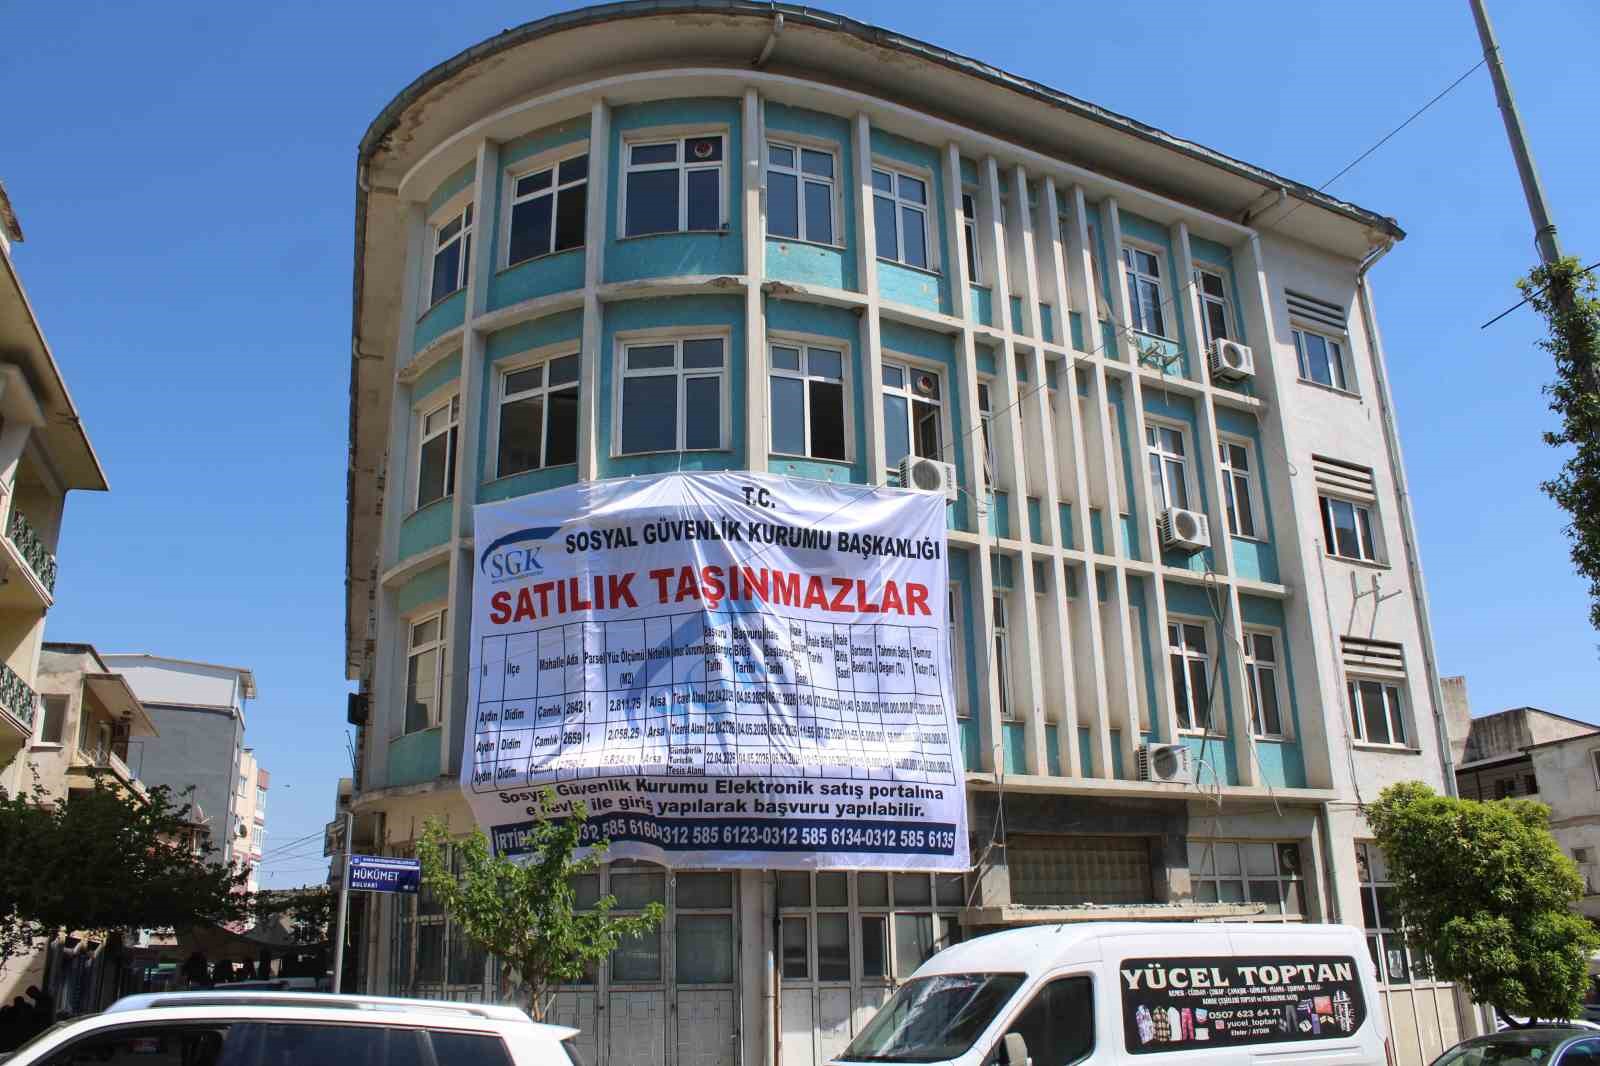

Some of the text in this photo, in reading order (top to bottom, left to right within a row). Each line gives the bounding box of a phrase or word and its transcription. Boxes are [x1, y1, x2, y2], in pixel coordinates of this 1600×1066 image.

[742, 487, 776, 509] T.C.
[566, 516, 940, 560] SOSYAL GÜVENLİK KURUMU BAŞKANLIĞI
[490, 546, 545, 578] SGK
[489, 564, 932, 625] SATILIK TAŞINMAZLAR
[566, 654, 579, 666] Ada
[584, 651, 606, 665] Parsel
[735, 661, 756, 674] Tarihi
[480, 710, 498, 726] Aydın
[504, 708, 525, 721] Didim
[649, 696, 667, 708] Arsa
[476, 741, 495, 755] Aydın
[500, 739, 522, 751] Didim
[647, 726, 666, 738] Arsa
[498, 767, 517, 779] Didim
[556, 778, 632, 797] Güvenlik
[635, 778, 709, 795] Kurumu
[715, 780, 814, 796] Elektronik
[820, 782, 863, 799] satış
[869, 783, 944, 800] portalına
[591, 797, 614, 811] ile
[619, 795, 653, 814] giriş
[657, 799, 747, 816] yapılarak
[755, 799, 830, 816] başvuru
[836, 799, 925, 818] yapılabilir.
[693, 825, 718, 844] 585
[724, 825, 798, 845] 6123-0312
[802, 825, 827, 844] 585
[831, 827, 897, 847] 6134-0312
[900, 828, 924, 847] 585
[928, 830, 954, 850] 6135
[353, 867, 399, 881] HÜKÜMET
[1121, 962, 1352, 990] YÜCEL TOPTAN
[1209, 1011, 1234, 1019] 0507
[1237, 1010, 1254, 1018] 623
[1257, 1009, 1270, 1017] 64
